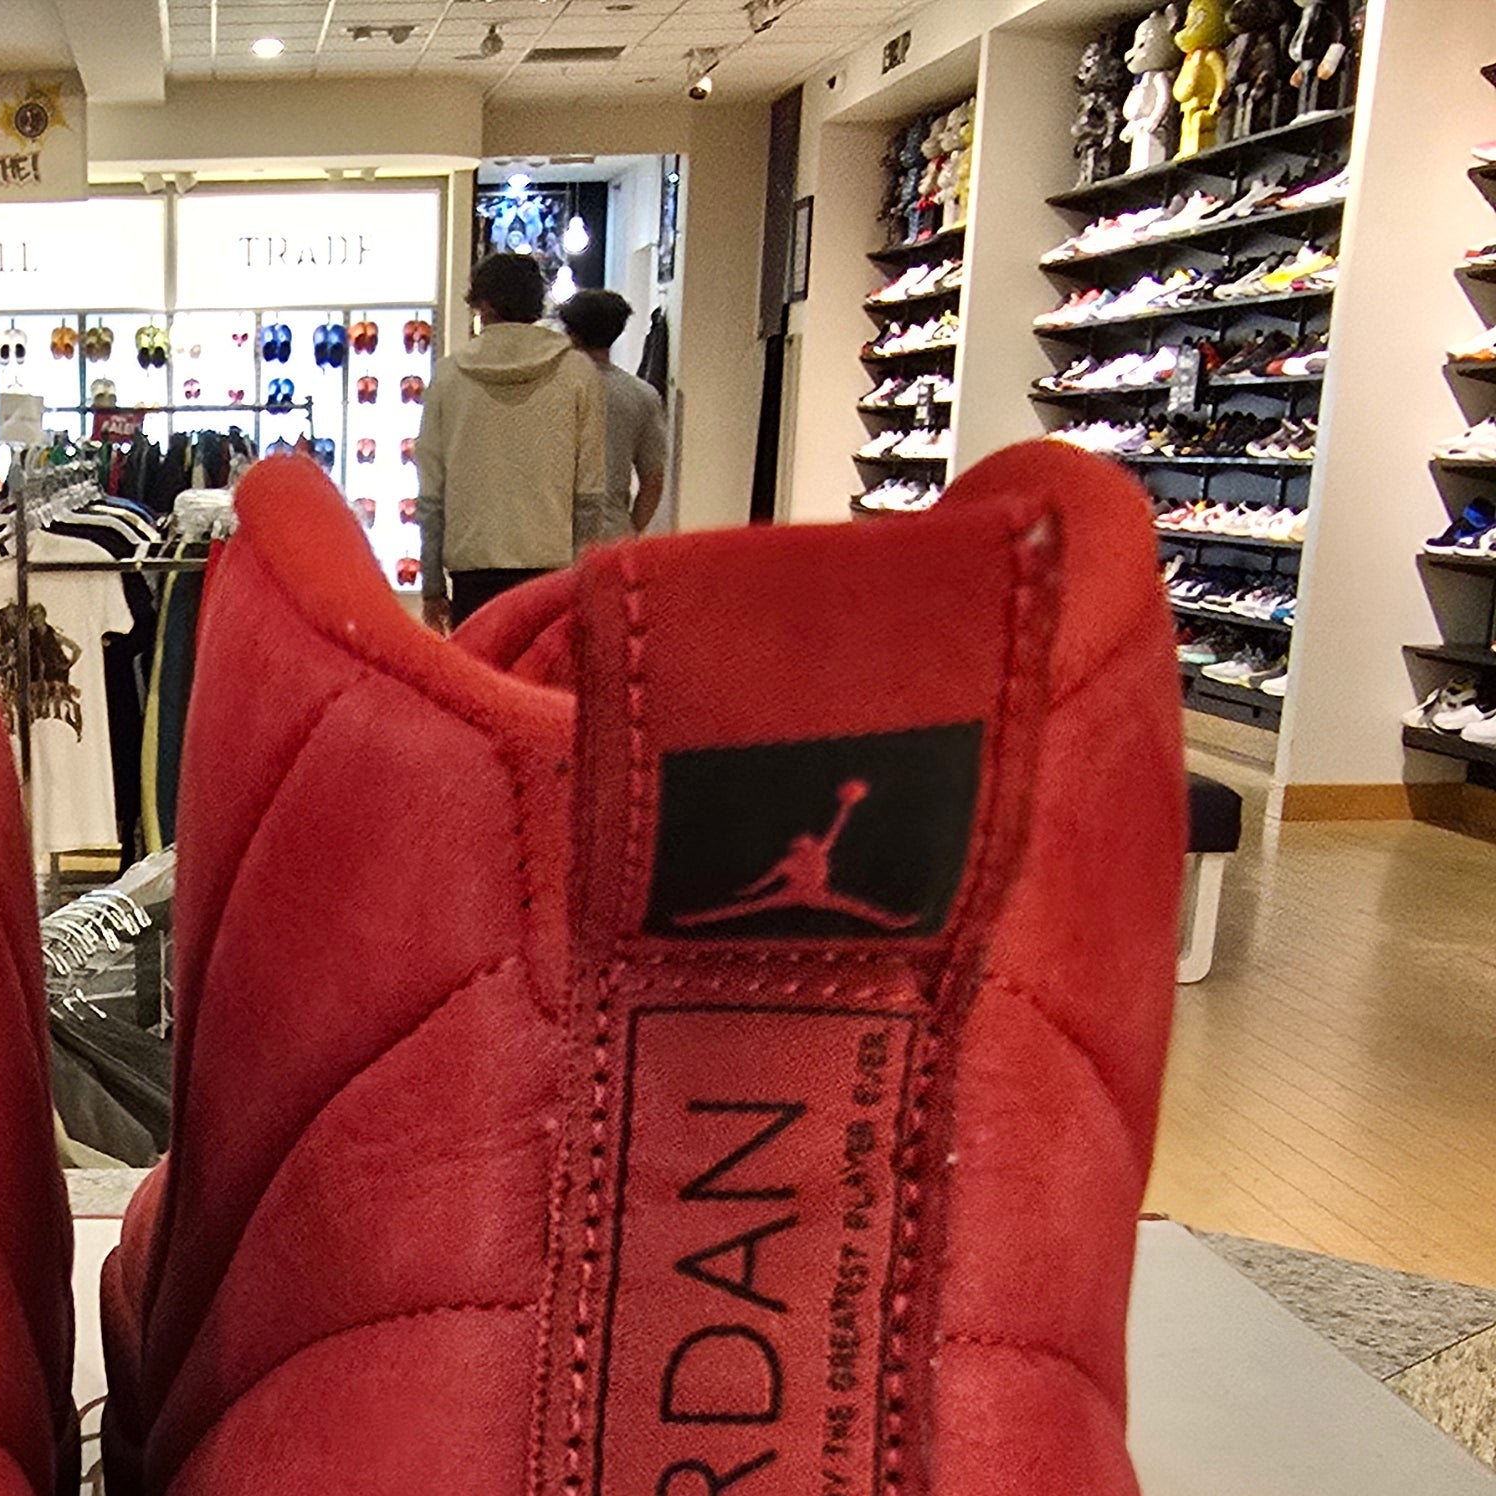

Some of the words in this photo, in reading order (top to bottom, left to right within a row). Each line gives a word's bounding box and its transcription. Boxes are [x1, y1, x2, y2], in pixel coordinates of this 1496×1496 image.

[237, 233, 374, 268] TRADE
[851, 1030, 891, 1107] EVER
[839, 1119, 881, 1233] PLAYER
[825, 1242, 870, 1394] GREATEST
[822, 1405, 857, 1458] THE
